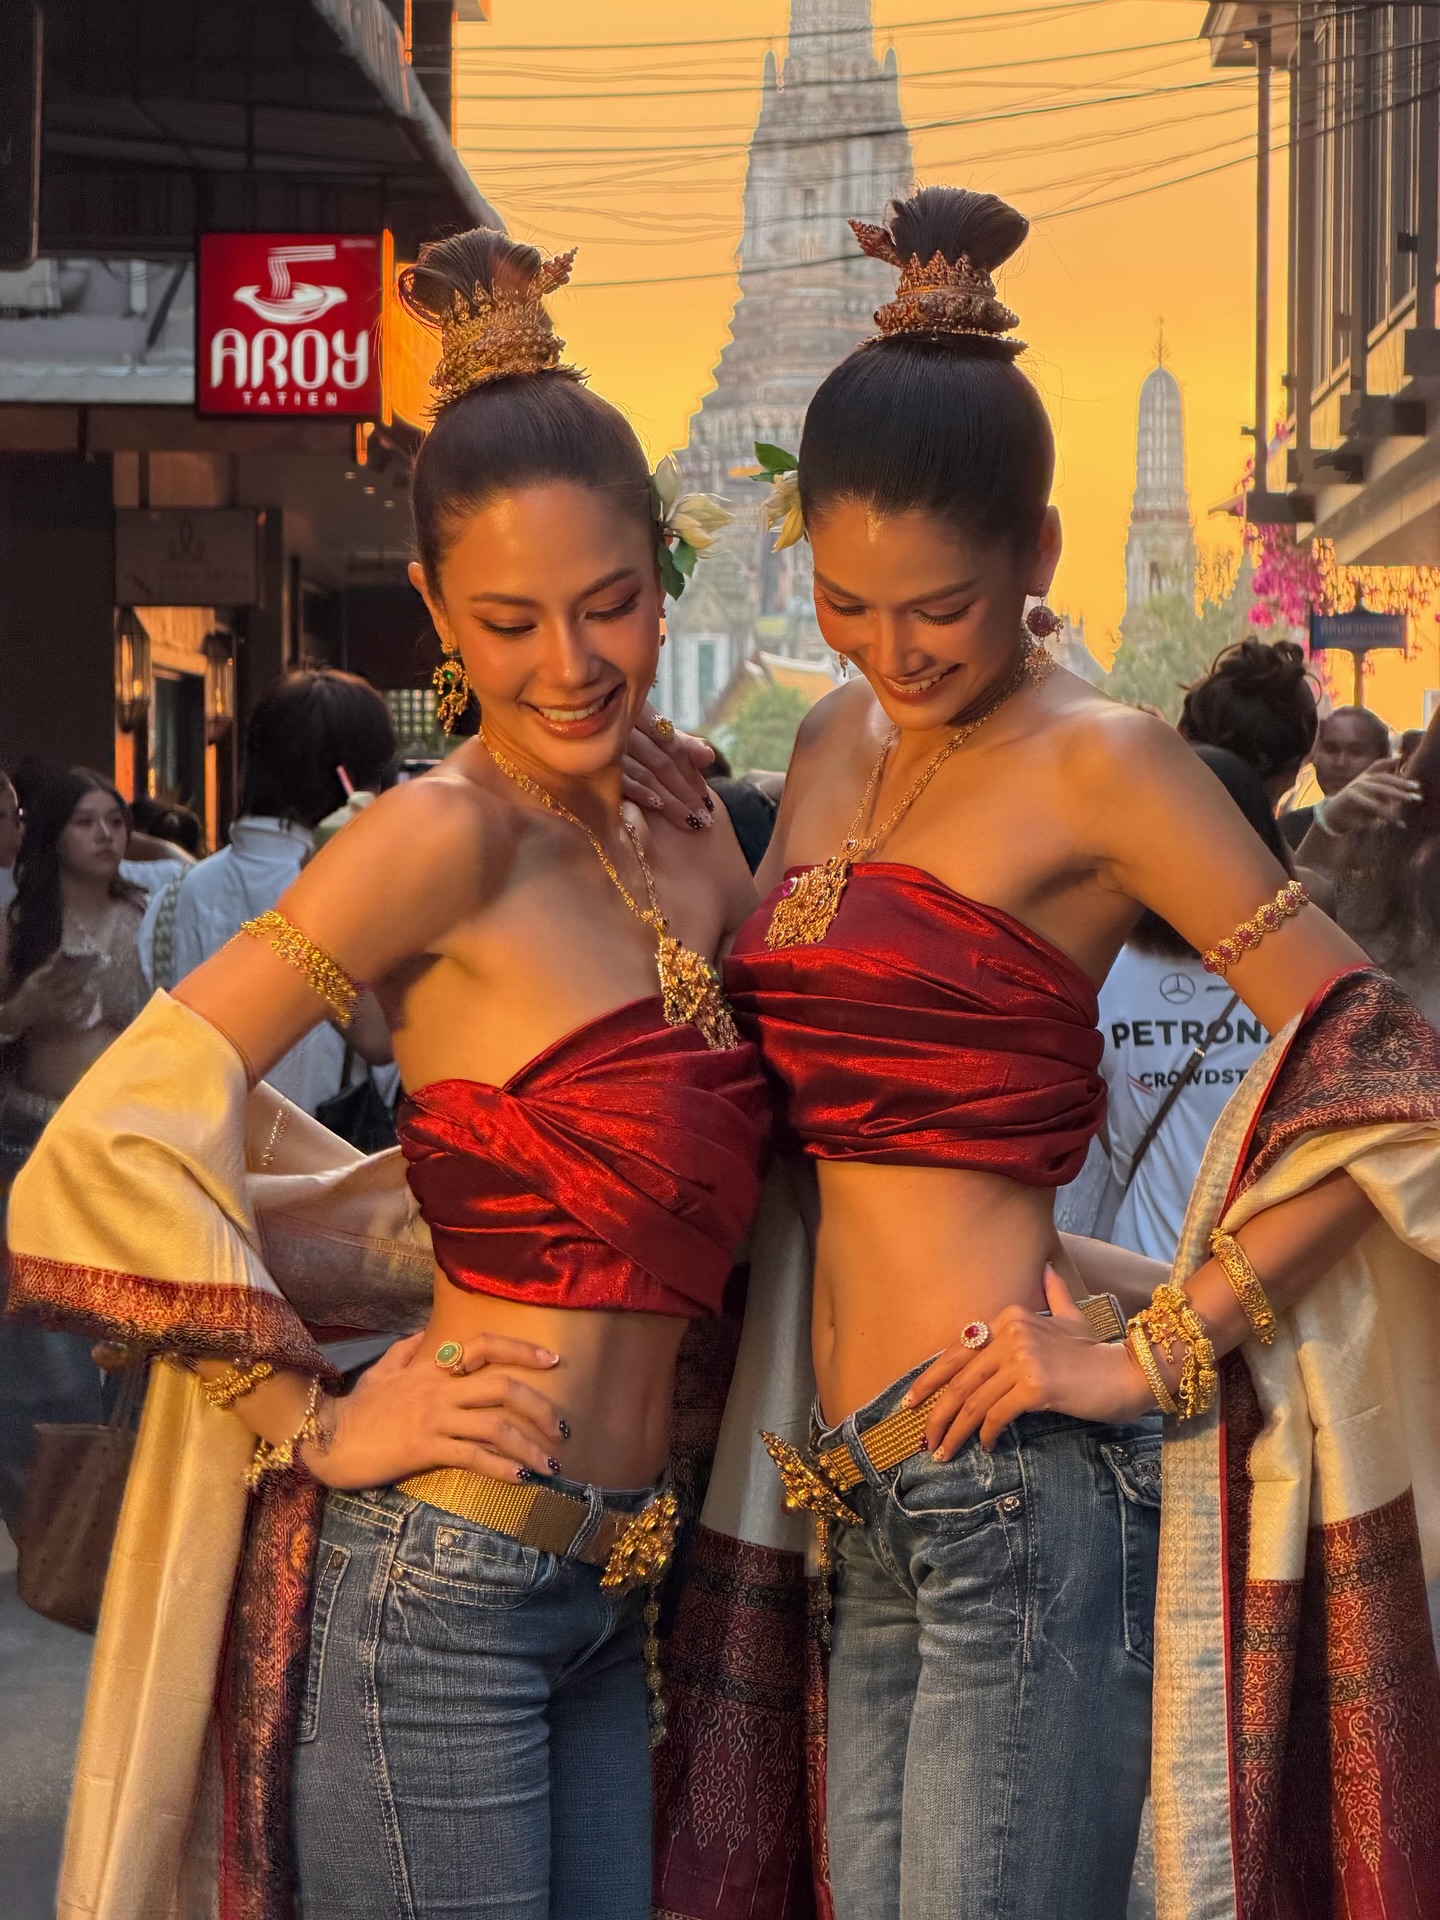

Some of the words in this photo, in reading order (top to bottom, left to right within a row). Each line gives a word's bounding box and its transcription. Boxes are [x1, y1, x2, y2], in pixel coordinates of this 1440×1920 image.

[211, 328, 369, 390] AROY
[242, 392, 338, 407] TATIEN
[1111, 1018, 1273, 1049] PETRON
